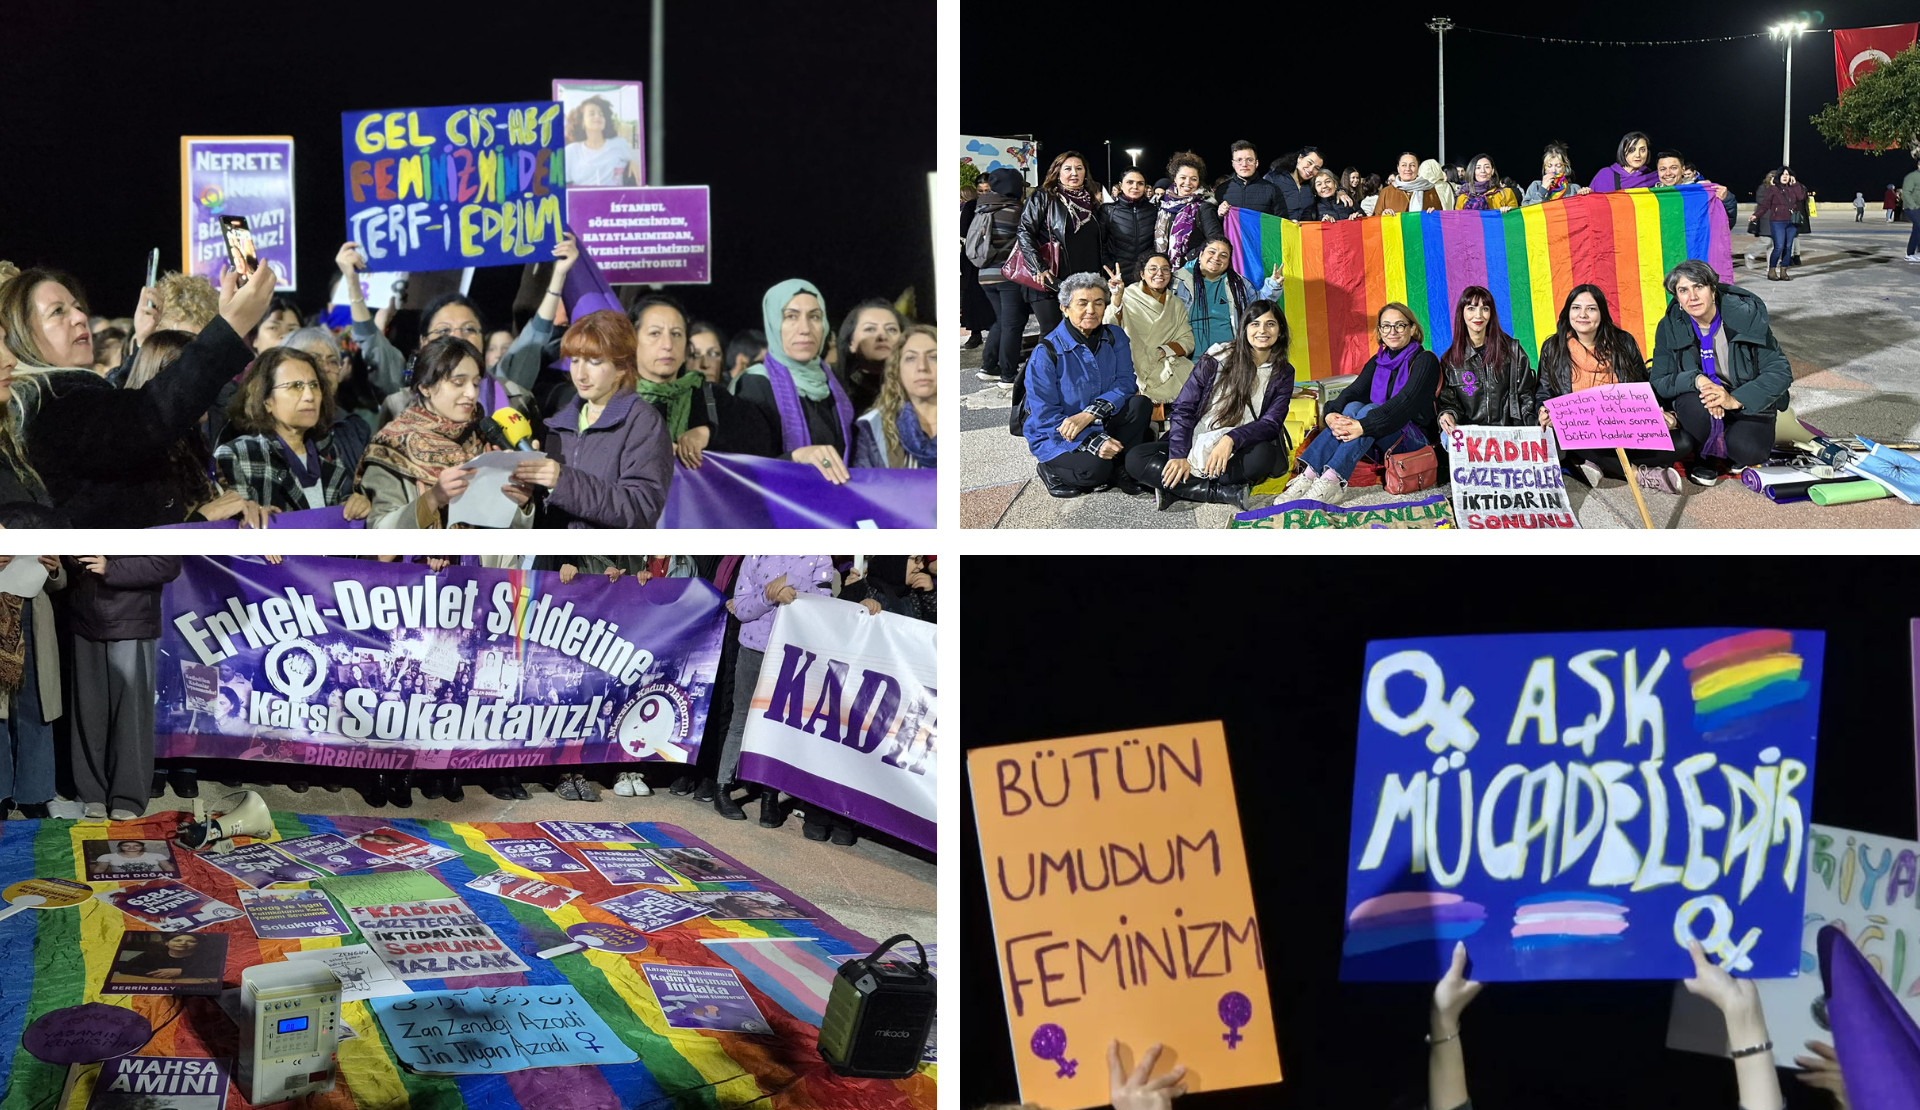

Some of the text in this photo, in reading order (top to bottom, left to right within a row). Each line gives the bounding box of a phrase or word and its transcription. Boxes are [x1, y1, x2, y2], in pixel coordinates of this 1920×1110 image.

[355, 112, 436, 154] GEL
[195, 150, 283, 171] NEFRETE
[610, 202, 666, 213] İSTANBUL
[459, 192, 563, 257] EDELİM
[588, 215, 688, 229] SÖZLEŞMESİNDEN,
[582, 231, 695, 242] HAYATLARIMIZDAN,
[596, 258, 687, 271] AZGEÇMİYORUZ!
[1551, 389, 1649, 409] bundan böyle hep
[1578, 406, 1596, 416] hep
[1600, 404, 1616, 413] tek
[1559, 418, 1591, 430] yalnız
[1629, 417, 1659, 426] sanma
[1562, 428, 1597, 441] bütün
[1466, 437, 1548, 463] KADIN
[1453, 464, 1565, 489] GAZETECİLER
[1462, 491, 1562, 510] İKTİDARIN
[1467, 513, 1574, 529] SONUNU
[173, 575, 654, 686] Erkek-Devlet Şiddetine
[607, 683, 690, 738] Mersin Kadın Platformu
[1506, 646, 1671, 762] AŞK
[249, 688, 603, 747] Karşı Sokaktayız!
[304, 743, 409, 769] BİRBİRİMİZ
[996, 737, 1203, 817] BÜTÜN
[1357, 745, 1807, 905] MÜCADELEDİR
[503, 842, 552, 855] 6284
[235, 855, 290, 873] SON!
[997, 828, 1222, 902] UMUDUM
[92, 871, 174, 880] ÇİLEM DOĞAN
[143, 894, 200, 915] Uygula!
[365, 903, 462, 918] KADIN
[260, 918, 339, 931] Sokaktayız!
[358, 913, 485, 929] GAZETECİLER
[374, 926, 486, 941] İKTİDARIN
[384, 938, 503, 955] SONUNU
[387, 951, 520, 974] YAZACAK
[1005, 906, 1264, 1017] FEMİNİZM
[649, 974, 739, 987] Kadın Düşmanı
[539, 993, 574, 1006] زن
[397, 1010, 586, 1039] Zan Zendgi Azadi
[874, 1029, 910, 1039] mikado
[409, 1033, 570, 1069] Jin Jiyan Azadi
[117, 1059, 219, 1075] MAHSA
[107, 1073, 218, 1093] AMINI
